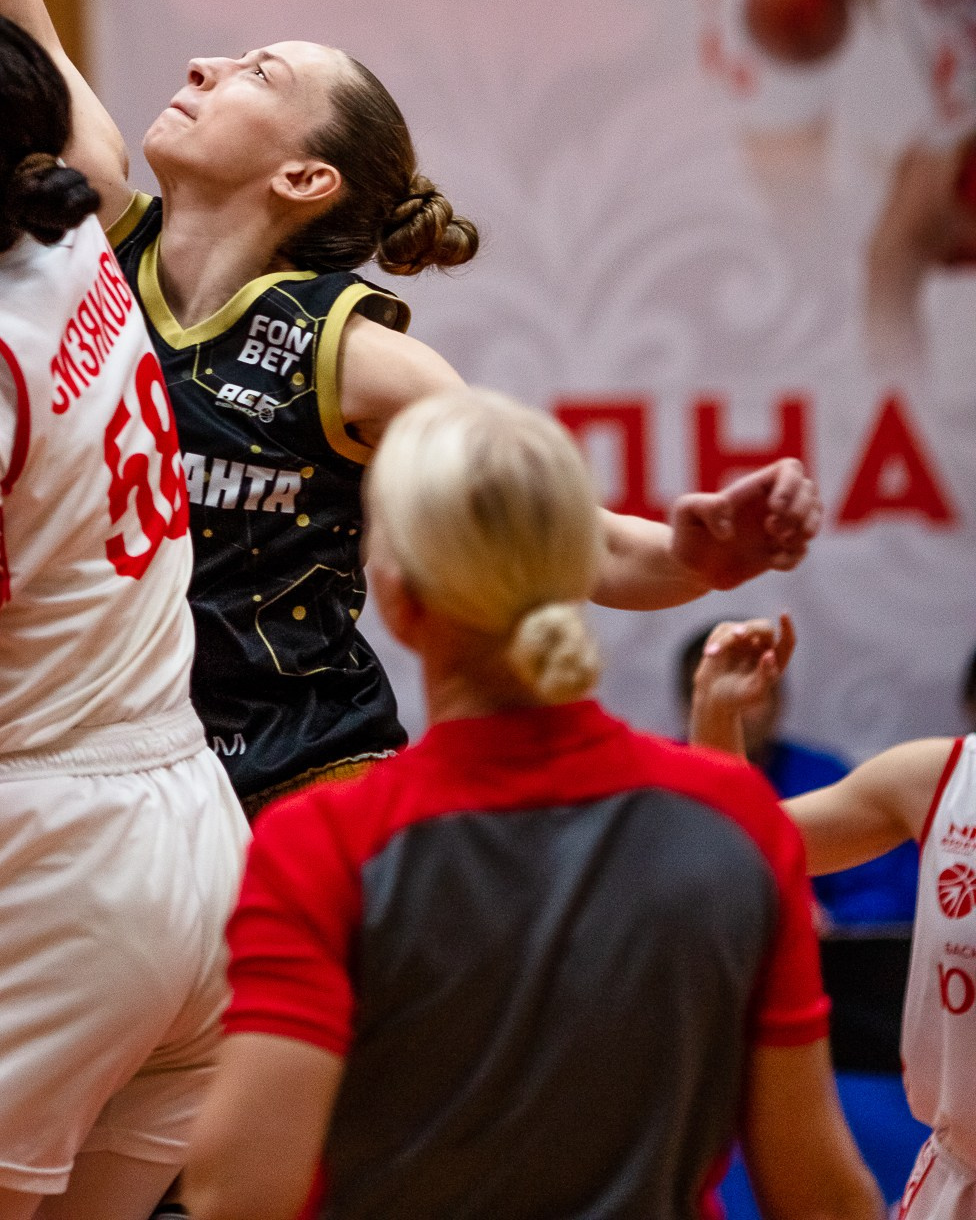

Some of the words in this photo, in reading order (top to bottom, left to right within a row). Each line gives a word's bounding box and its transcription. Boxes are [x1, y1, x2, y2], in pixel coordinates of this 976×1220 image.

[50, 251, 132, 415] СИЗЯКОВ
[237, 338, 301, 376] BET
[249, 314, 314, 355] FON
[104, 352, 191, 580] 58
